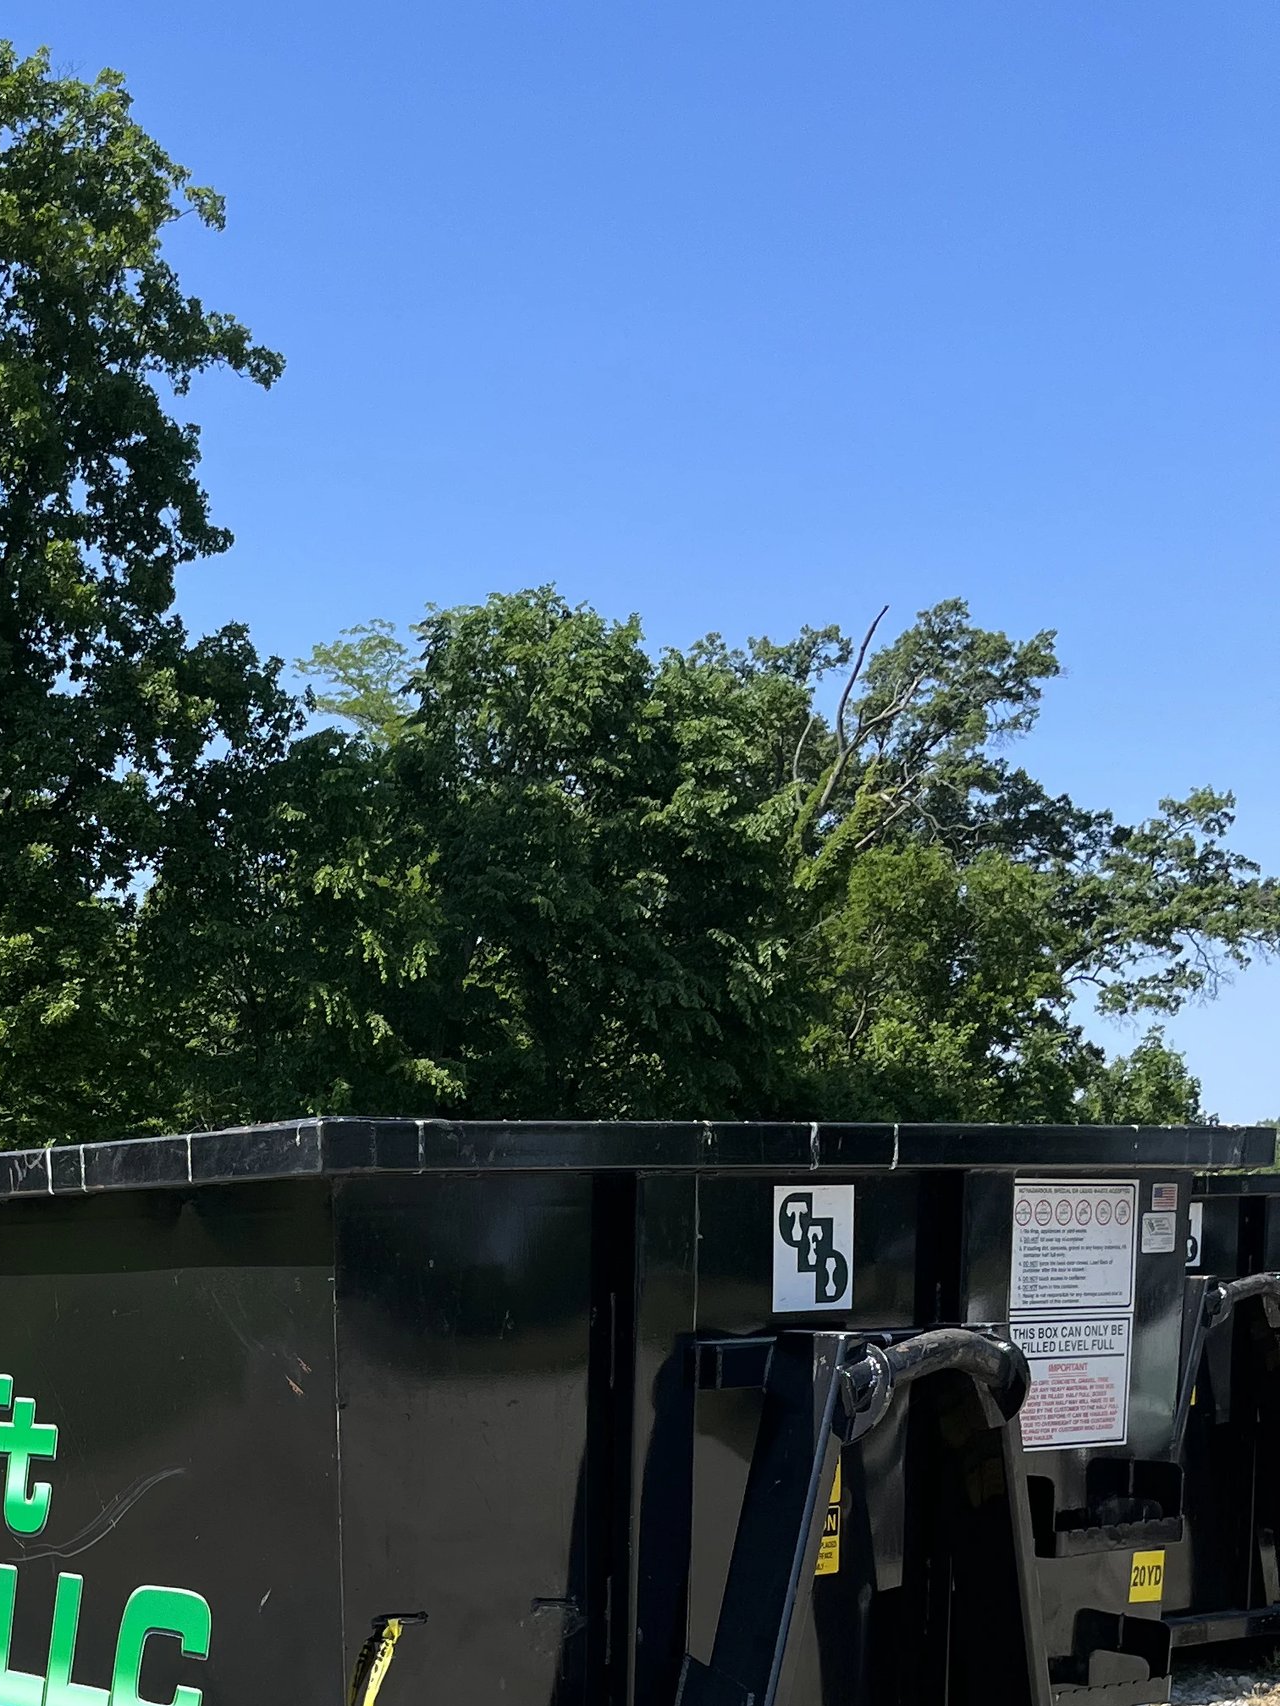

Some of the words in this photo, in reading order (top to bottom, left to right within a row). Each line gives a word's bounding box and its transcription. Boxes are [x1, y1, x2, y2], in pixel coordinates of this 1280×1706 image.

[1013, 1328, 1035, 1339] THIS
[1038, 1327, 1058, 1339] BOX
[1061, 1326, 1081, 1337] CAN
[1084, 1325, 1108, 1337] ONLY
[1111, 1325, 1123, 1335] BE
[1022, 1341, 1055, 1353] FILLED
[1059, 1340, 1089, 1352] LEVEL
[1091, 1339, 1114, 1350] FULL
[1048, 1362, 1088, 1372] IMPORTANT
